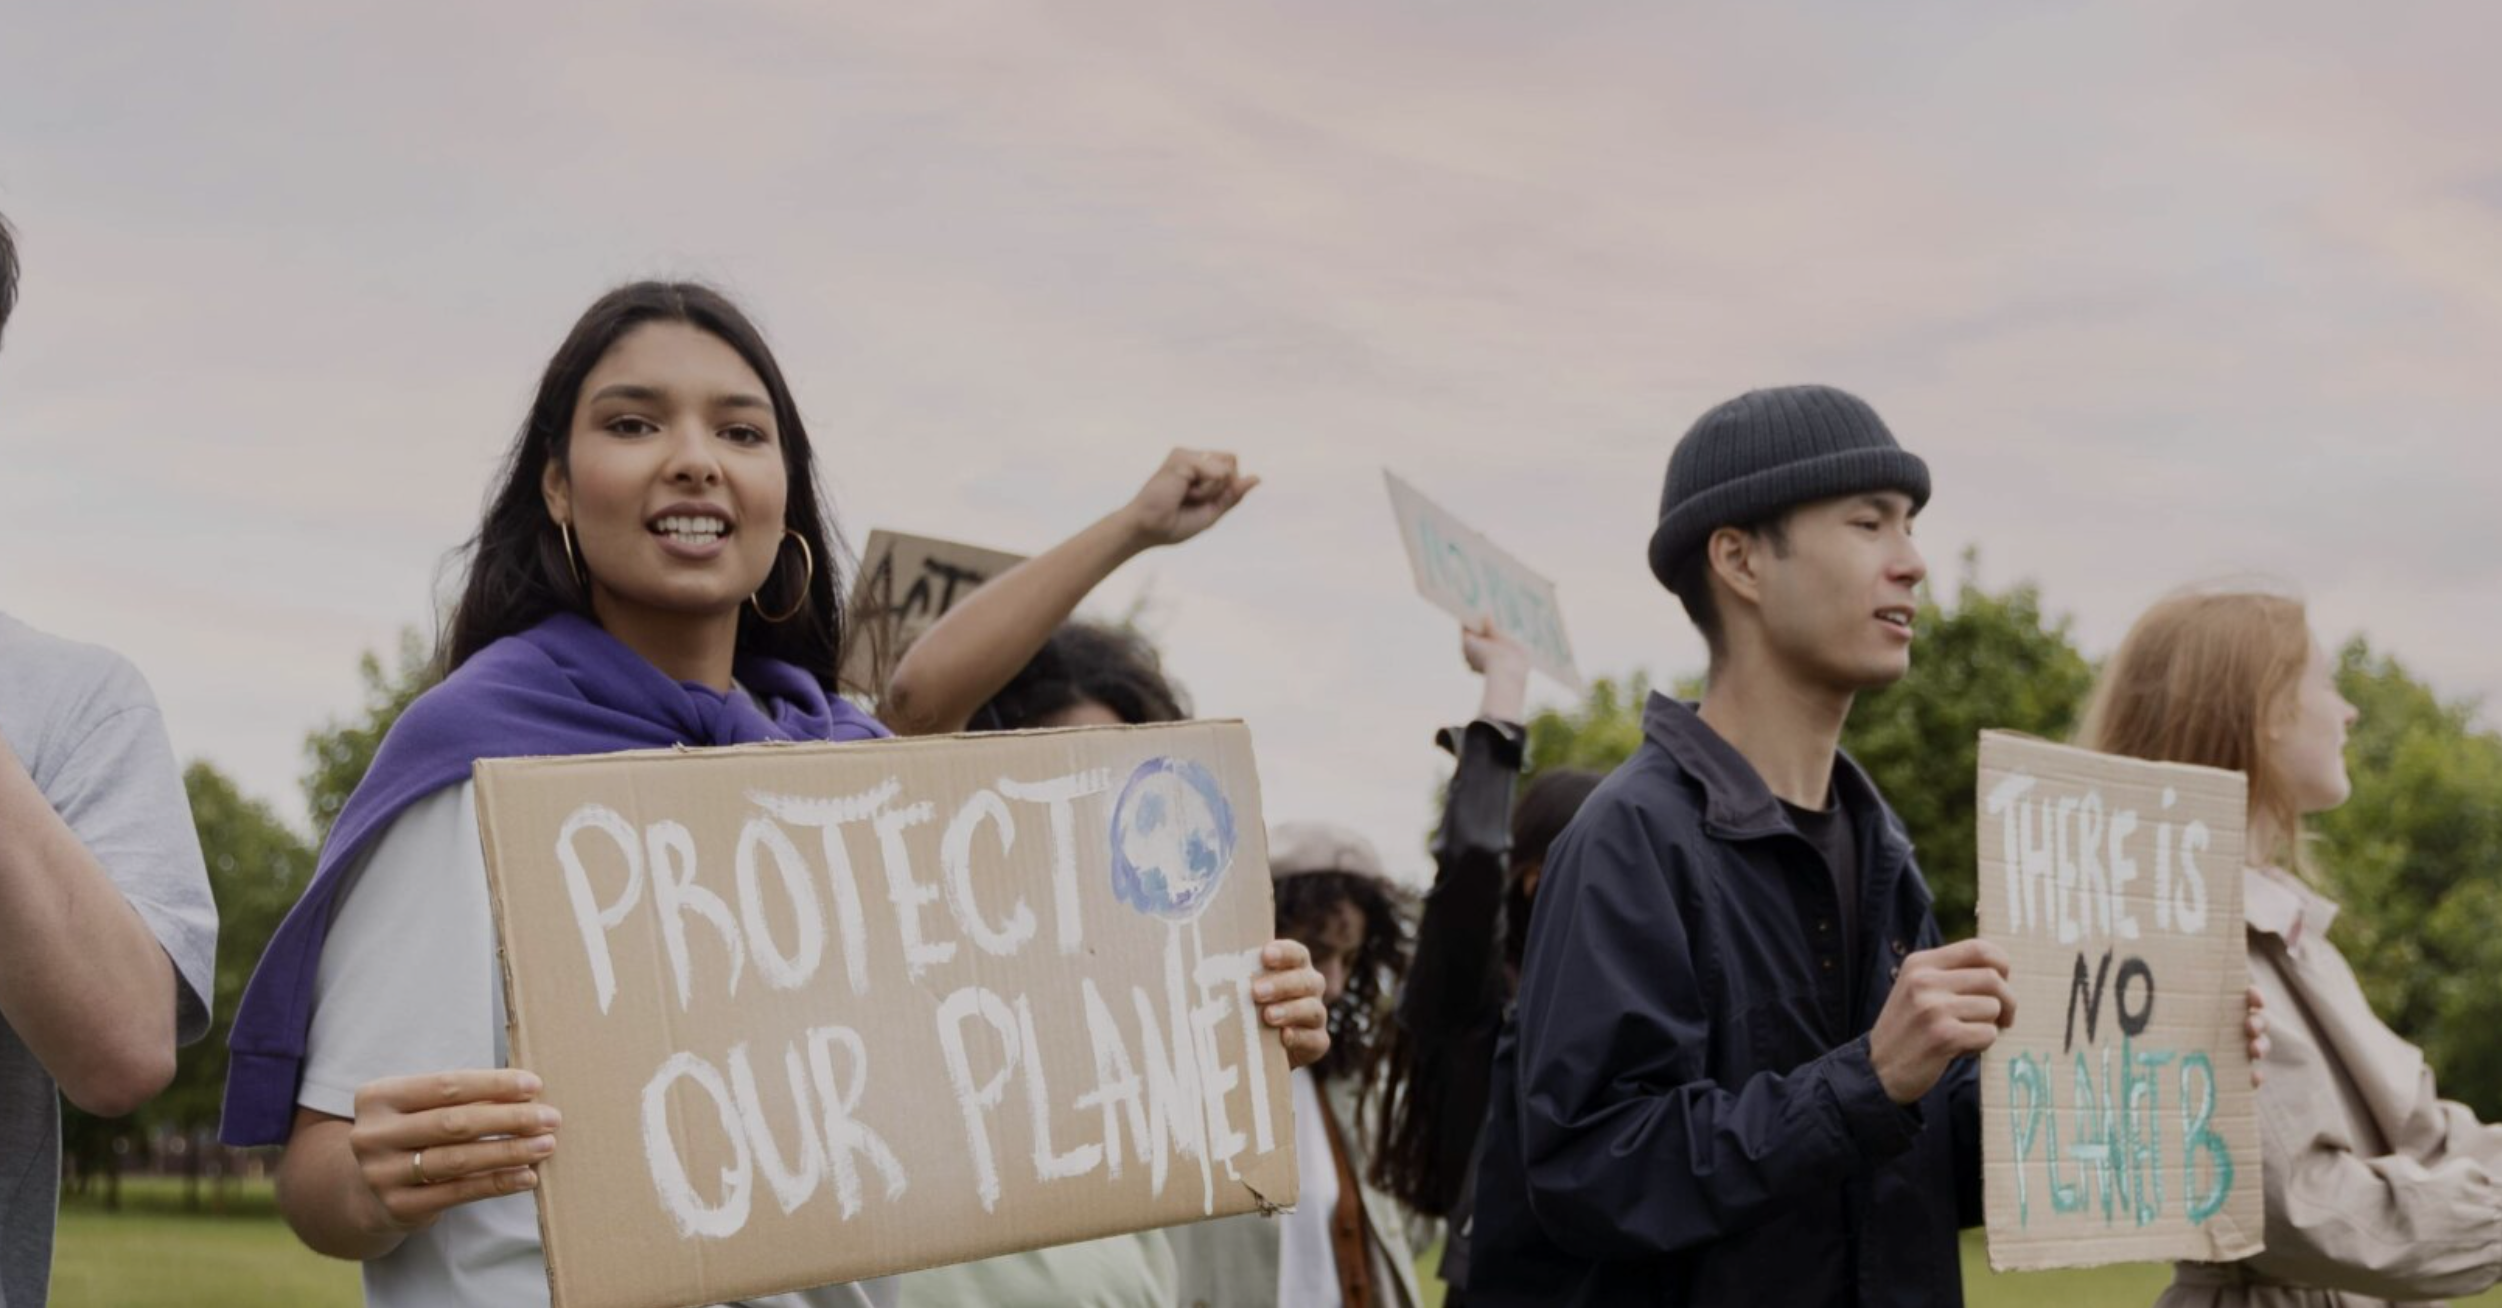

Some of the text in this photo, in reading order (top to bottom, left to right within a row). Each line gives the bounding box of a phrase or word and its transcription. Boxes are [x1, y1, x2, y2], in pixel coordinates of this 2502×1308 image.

[555, 766, 1111, 1014] PROTECT
[1987, 768, 2141, 944] THERE
[642, 945, 1275, 1240] OUR PLANET
[2064, 945, 2156, 1054] NO
[2008, 1036, 2235, 1229] PLANET B
